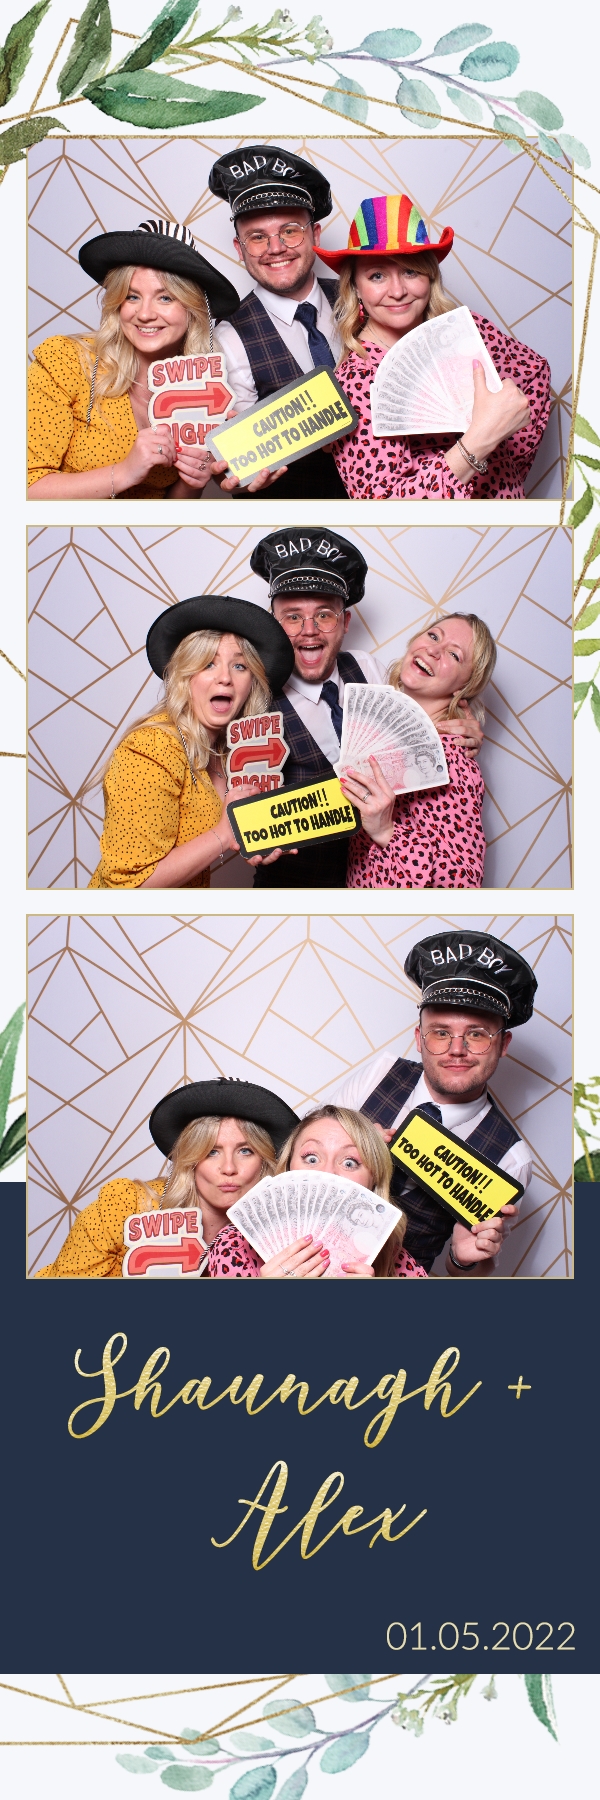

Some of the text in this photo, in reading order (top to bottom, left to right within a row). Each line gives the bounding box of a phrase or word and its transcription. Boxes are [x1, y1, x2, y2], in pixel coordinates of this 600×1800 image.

[229, 155, 267, 179] BAD
[152, 356, 224, 387] SWIPE
[252, 390, 317, 437] CAUTION!!
[157, 422, 221, 446] IGH
[230, 449, 258, 472] TOO
[256, 436, 282, 460] HOT
[281, 427, 300, 446] TO
[297, 400, 349, 438] HANDLE
[275, 537, 312, 559] BAD
[230, 714, 281, 744] SWIPE
[270, 788, 330, 819] CAUTION!!
[243, 805, 353, 844] TOO HOT TO HANDLE
[430, 943, 473, 966] BAD
[397, 1136, 495, 1223] TOO HOT TO HANDLE
[433, 1144, 494, 1194] CAUTION!!
[128, 1211, 199, 1242] SWIPE
